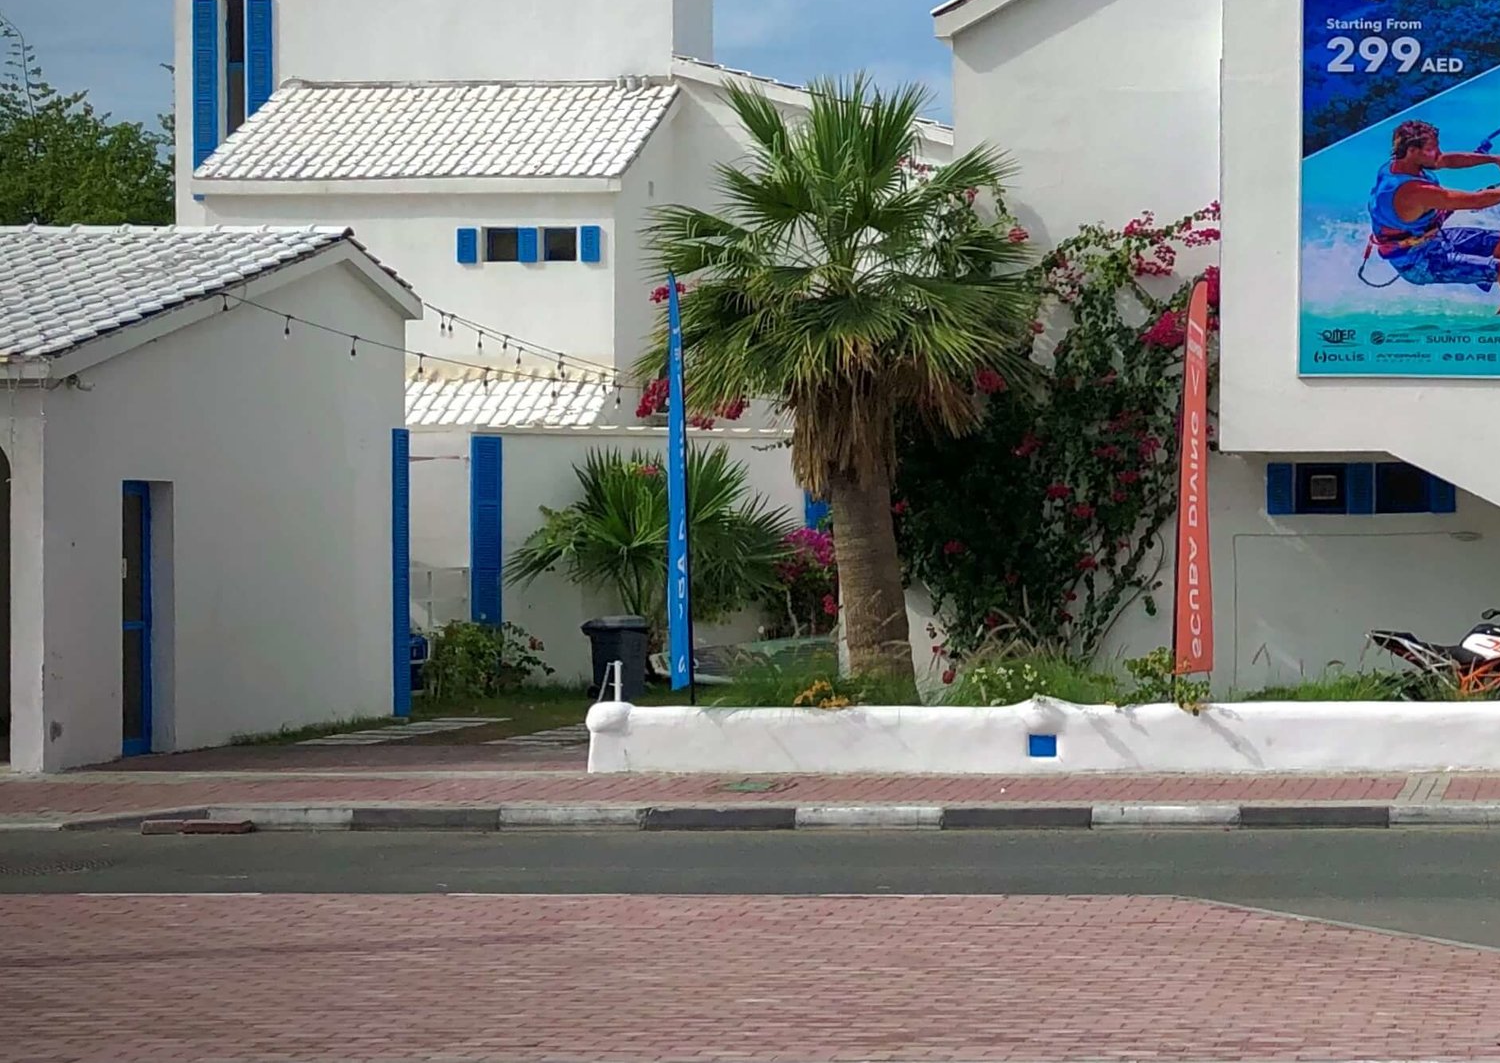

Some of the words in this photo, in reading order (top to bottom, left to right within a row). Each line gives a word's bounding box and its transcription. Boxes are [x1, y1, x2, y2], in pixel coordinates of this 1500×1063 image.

[1326, 18, 1382, 32] Starting
[1386, 18, 1422, 30] From
[1326, 35, 1422, 73] 299
[1421, 57, 1463, 73] AED
[1426, 335, 1471, 344] SUUNTO
[1455, 353, 1496, 361] BARE
